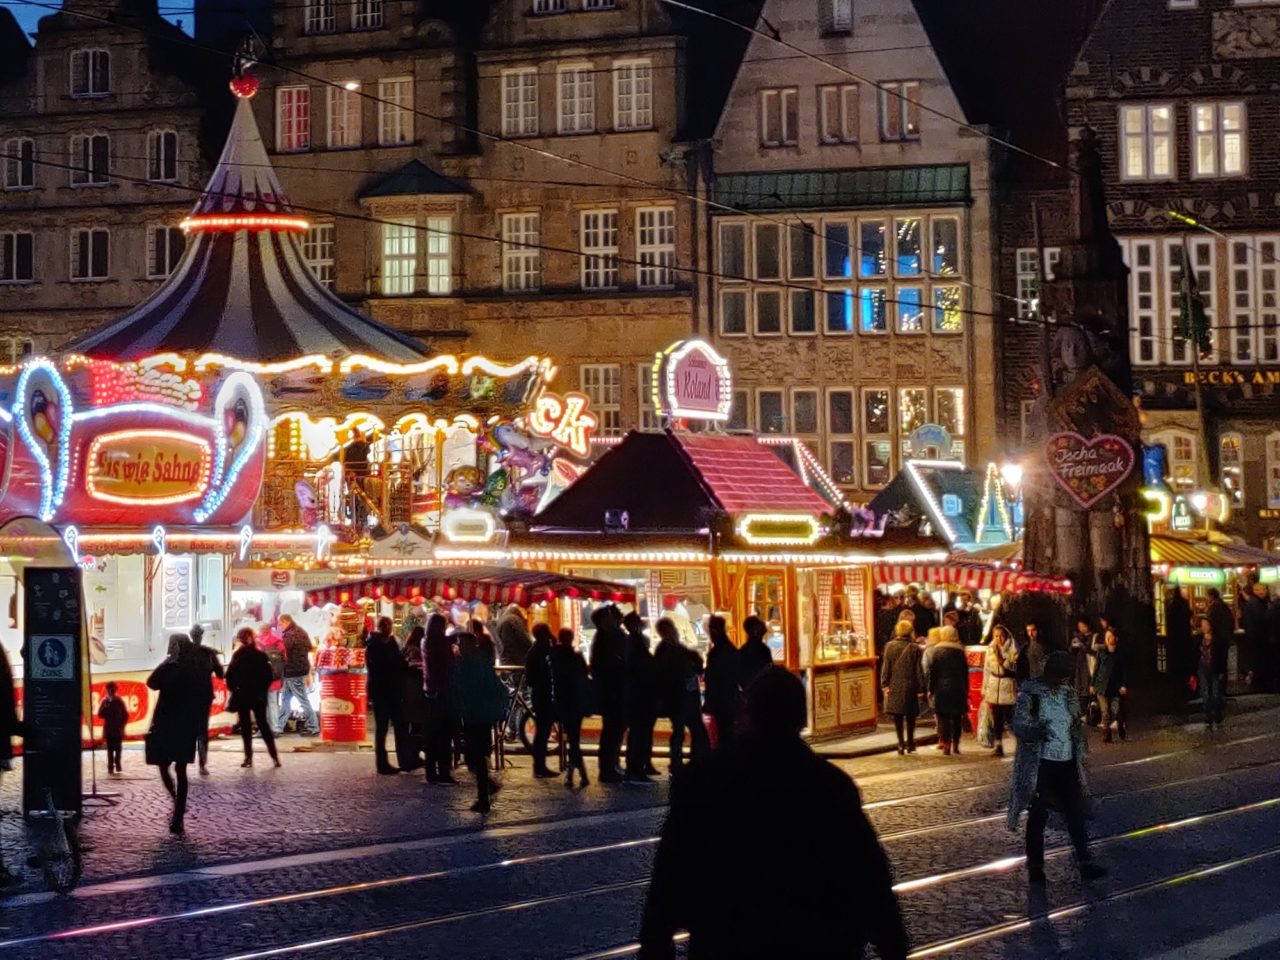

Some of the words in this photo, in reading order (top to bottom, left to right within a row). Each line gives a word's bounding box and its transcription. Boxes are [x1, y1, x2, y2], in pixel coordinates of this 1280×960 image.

[122, 452, 150, 485] wie
[153, 451, 201, 486] Sahne
[1059, 456, 1125, 478] Freimaak
